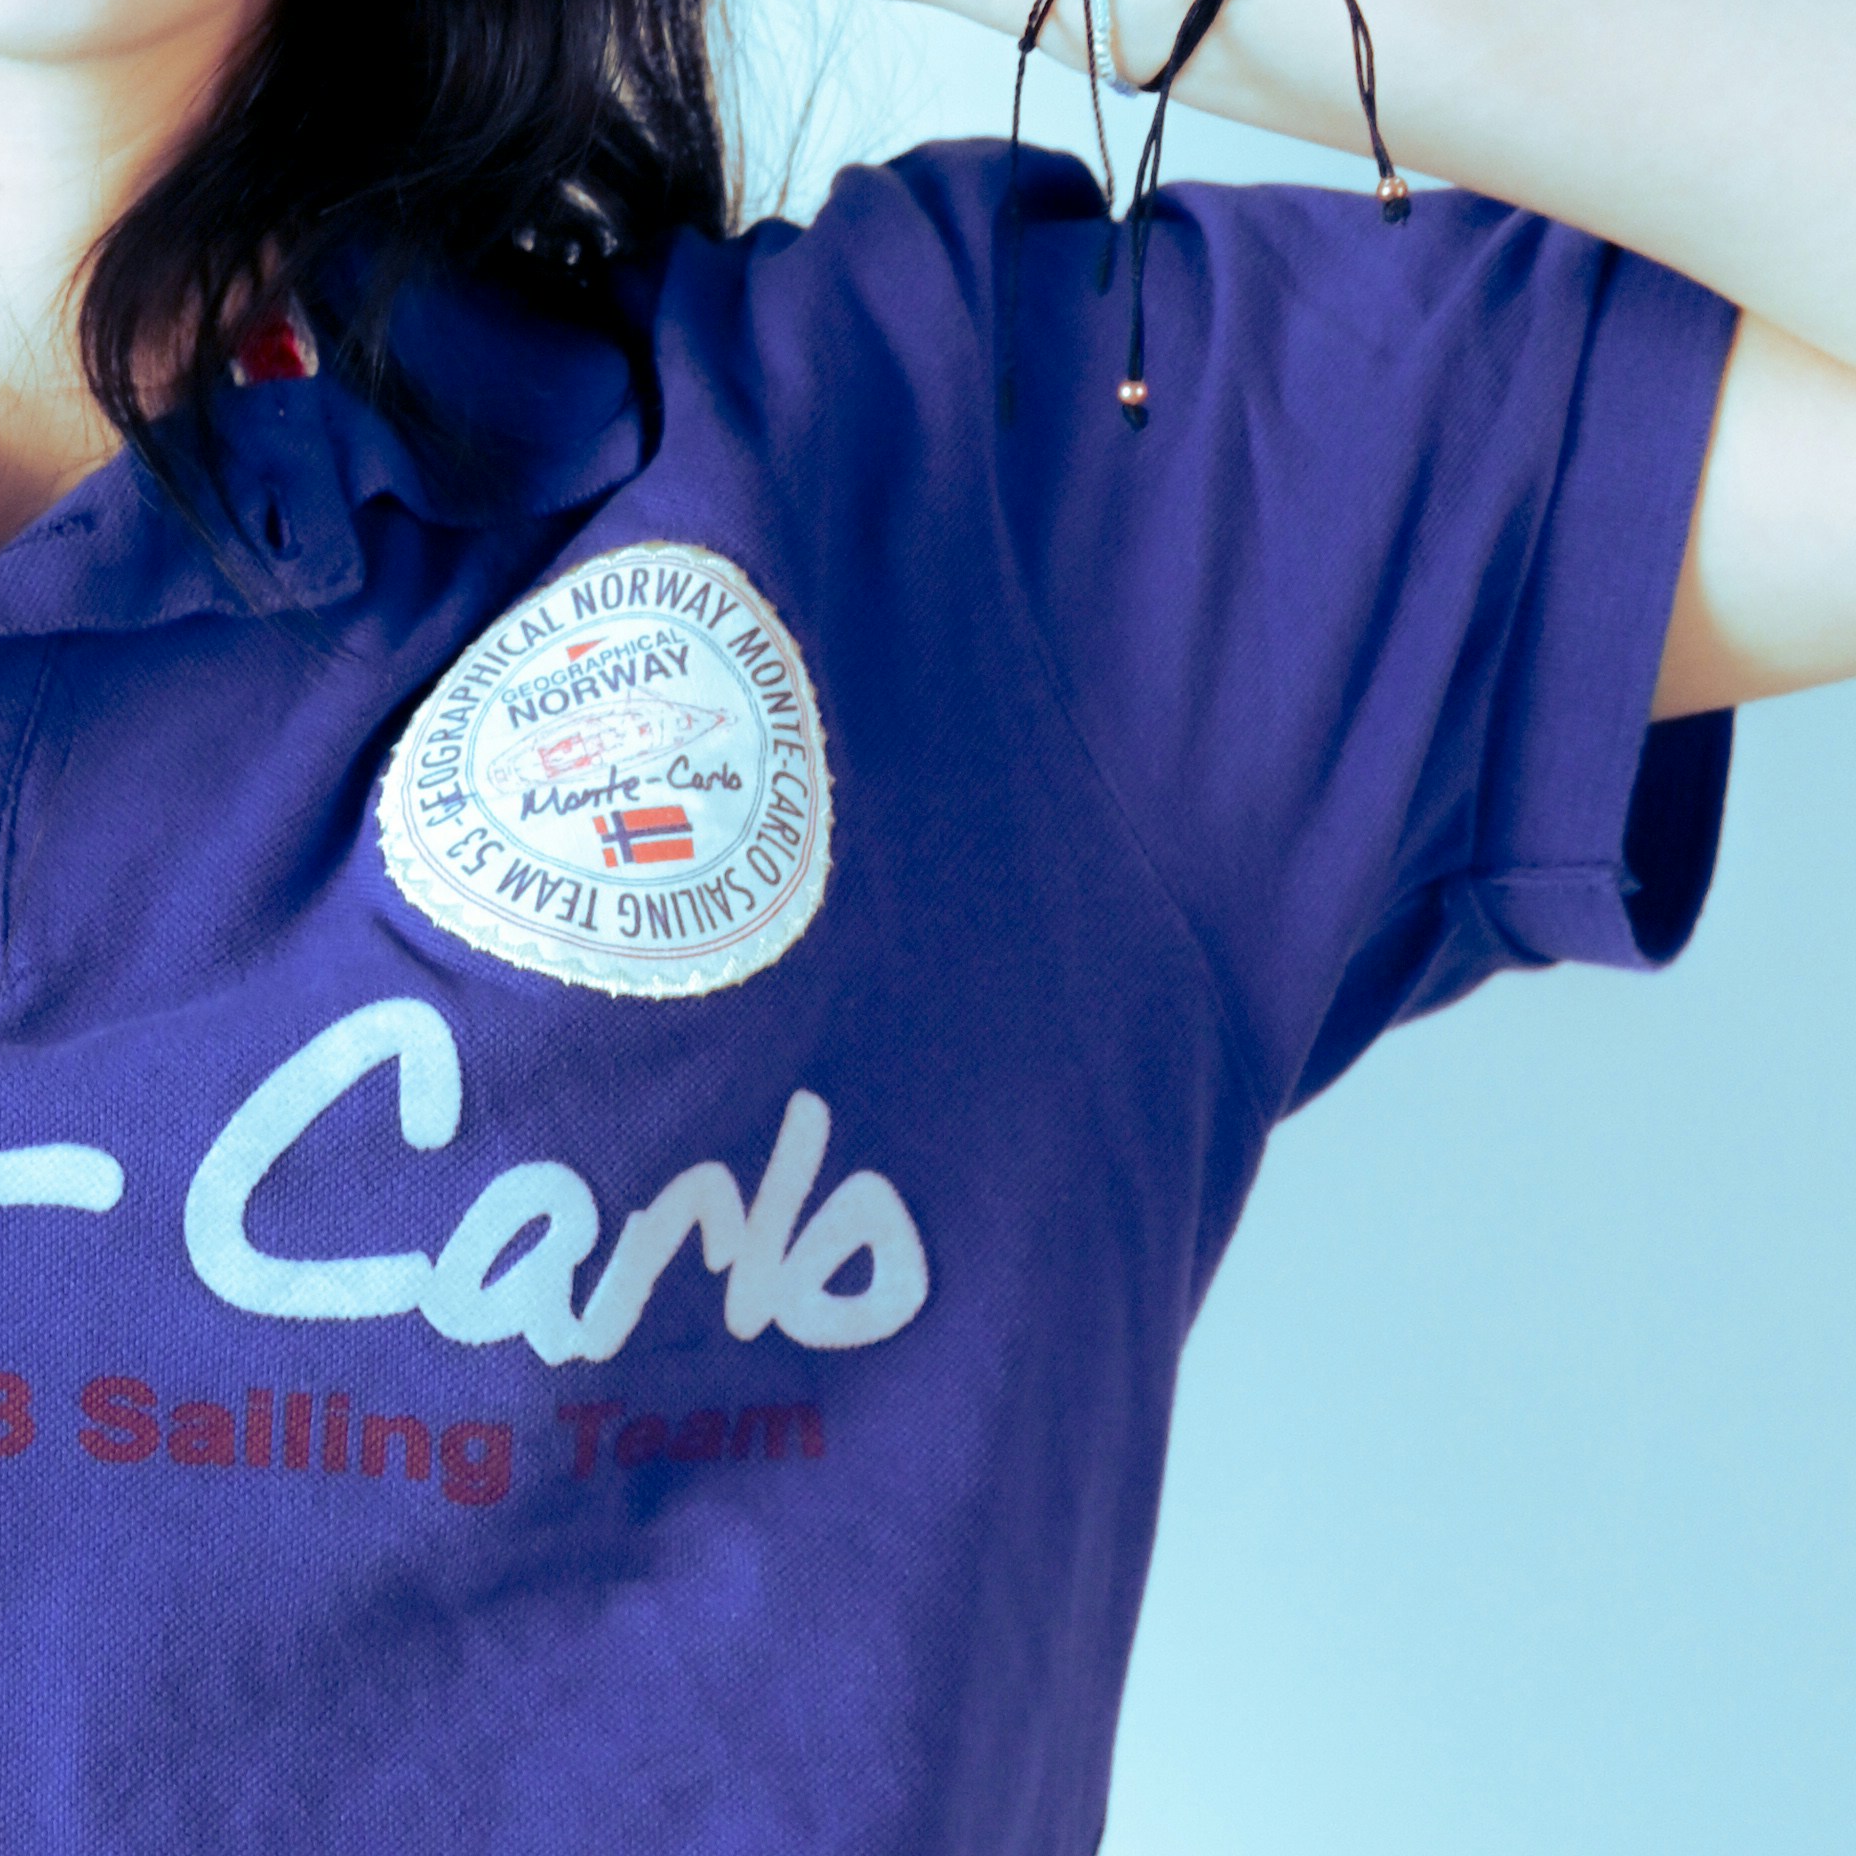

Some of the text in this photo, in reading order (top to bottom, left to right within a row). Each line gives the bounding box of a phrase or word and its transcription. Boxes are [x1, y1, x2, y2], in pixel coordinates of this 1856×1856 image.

[570, 567, 740, 630] NORWAY
[501, 628, 686, 704] GEOGRAPHICAL
[507, 645, 690, 729] NORWAY
[417, 607, 565, 828] GEOGRAPHICAL
[727, 626, 809, 887] MONTE-CARLO
[496, 858, 599, 932] TEAM
[617, 866, 756, 940] SAILING
[78, 1374, 515, 1506] Sailing
[556, 1400, 827, 1482] Team
